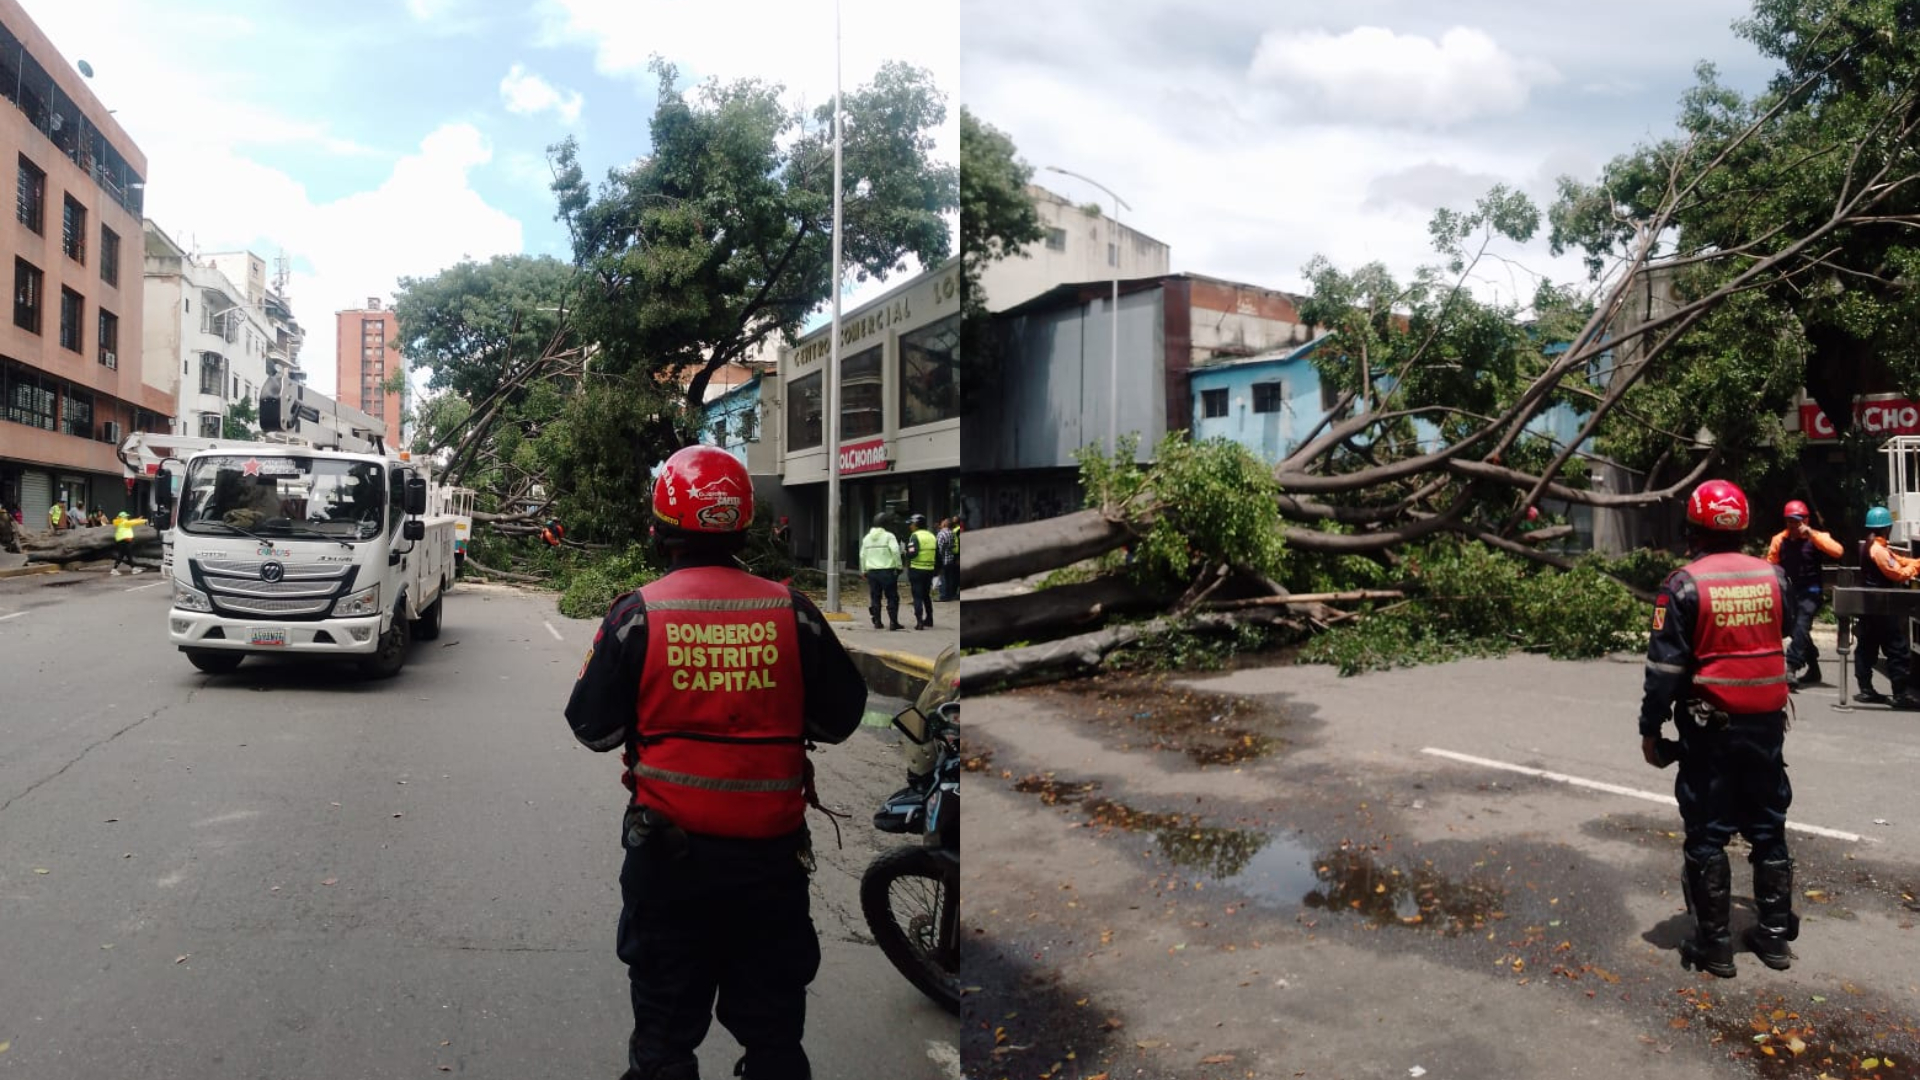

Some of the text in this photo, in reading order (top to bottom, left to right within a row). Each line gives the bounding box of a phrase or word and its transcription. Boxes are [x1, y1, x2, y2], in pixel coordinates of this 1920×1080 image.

[794, 336, 830, 367] CENTRO
[1708, 583, 1772, 599] BOMBEROS
[1711, 597, 1774, 613] DISTRITO
[1715, 611, 1773, 627] CAPITAL
[666, 621, 777, 644] BOMBEROS
[667, 644, 779, 668] DISTRITO
[672, 669, 777, 692] CAPITAL
